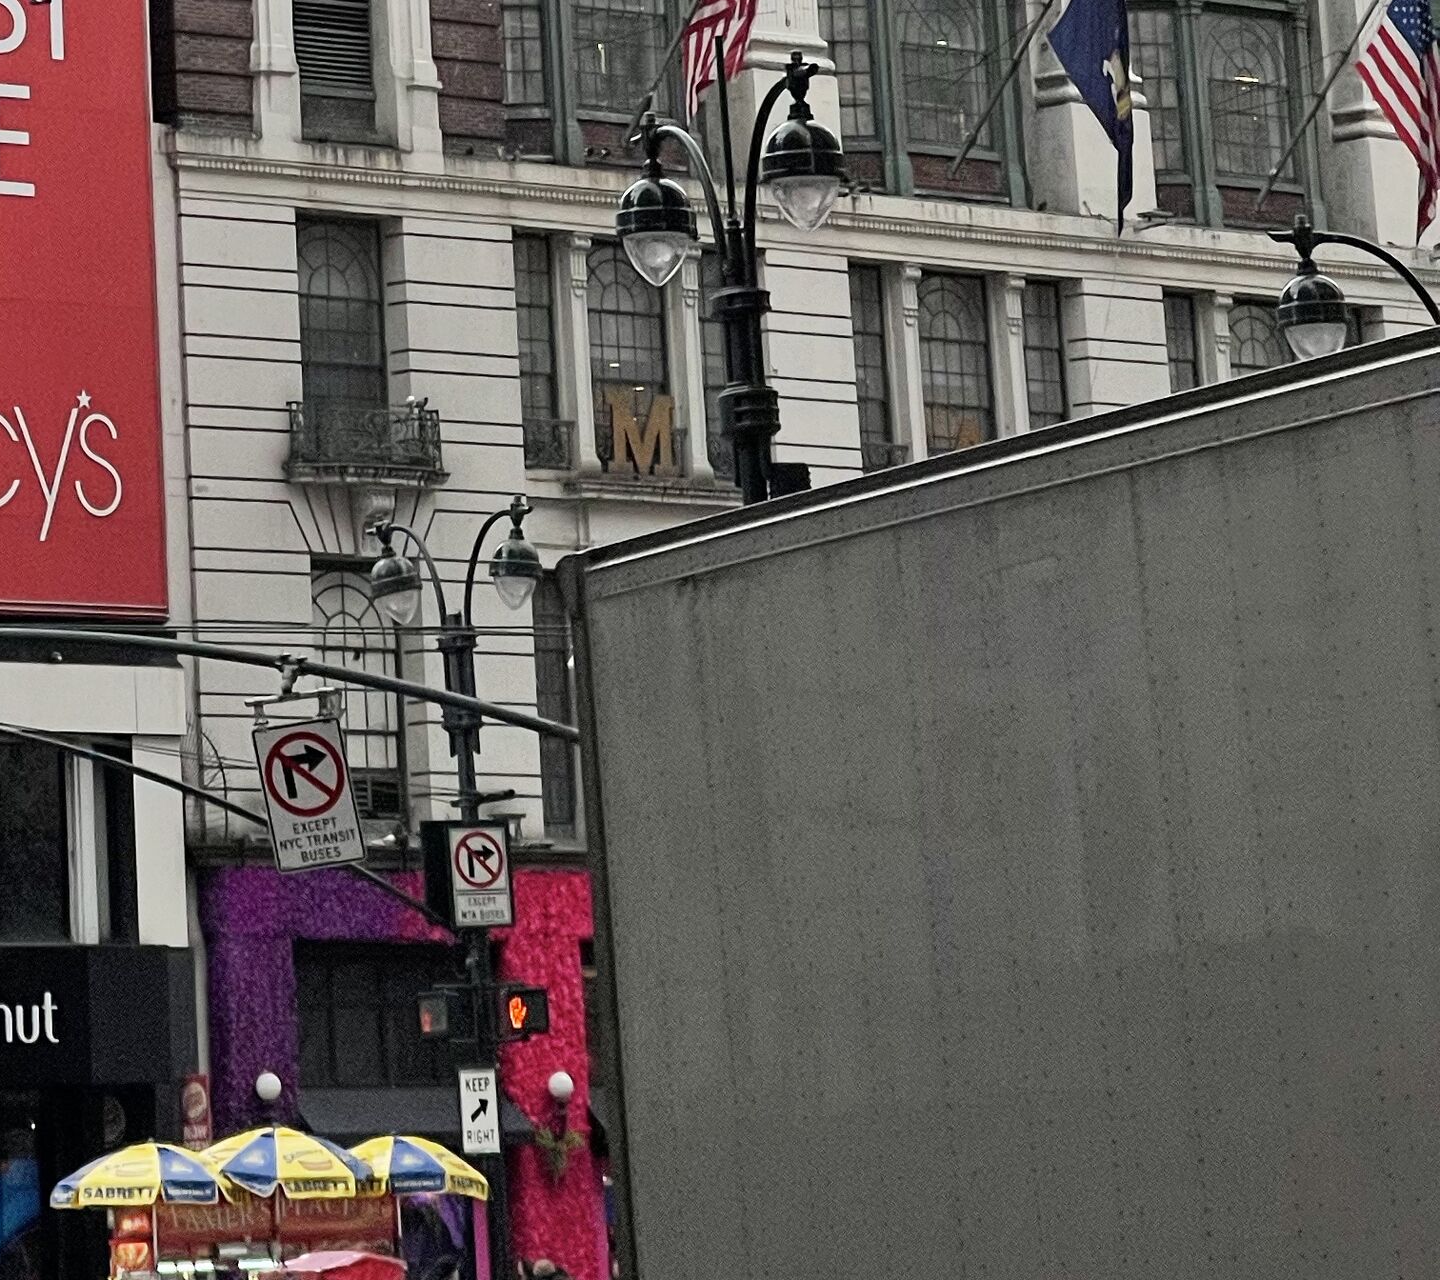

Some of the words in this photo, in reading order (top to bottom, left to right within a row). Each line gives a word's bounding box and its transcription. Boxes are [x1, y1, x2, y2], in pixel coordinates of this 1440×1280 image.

[606, 392, 677, 477] M
[292, 816, 338, 835] EXCEPT
[279, 837, 303, 851] NYC
[306, 828, 356, 847] TRANSIT
[300, 846, 342, 863] BUSES
[464, 1076, 491, 1093] KEEP
[466, 1128, 495, 1144] RIGHT
[83, 1185, 155, 1200] SABRETT
